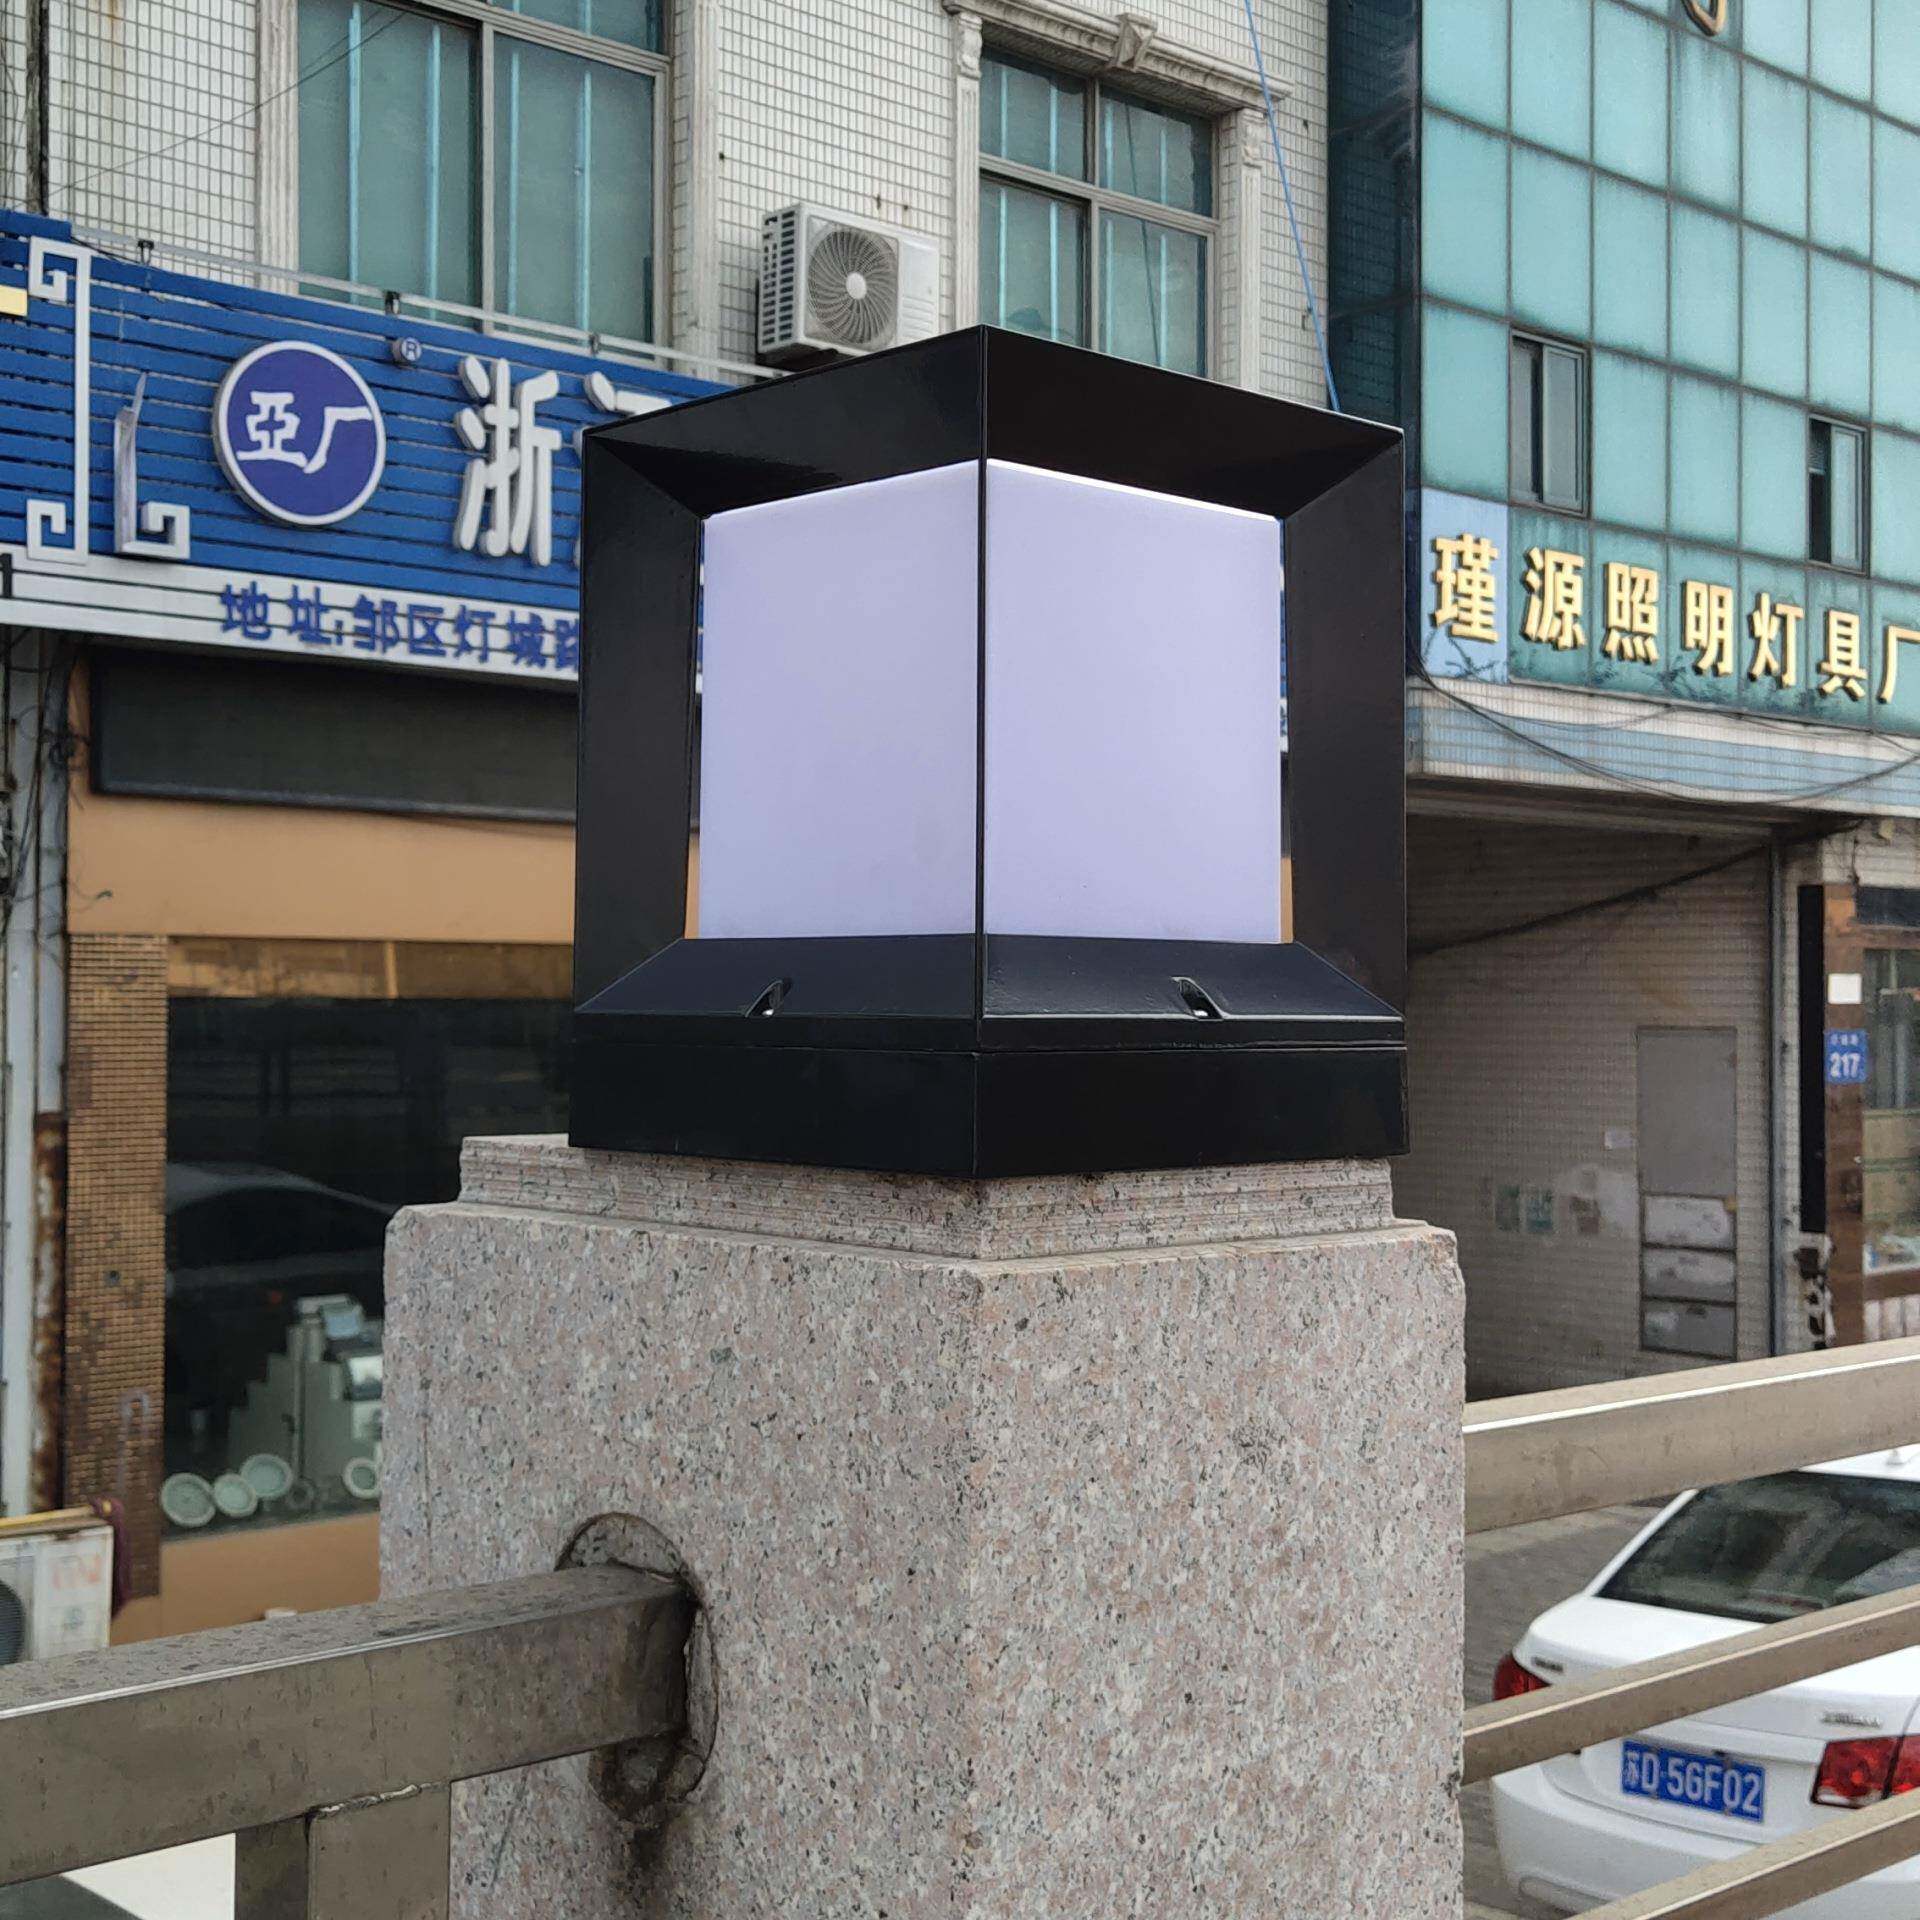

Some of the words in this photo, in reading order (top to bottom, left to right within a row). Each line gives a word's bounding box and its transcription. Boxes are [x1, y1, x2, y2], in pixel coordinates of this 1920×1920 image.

[1432, 533, 1920, 703] 瑾源照明灯具厂
[1830, 1052, 1860, 1078] 217
